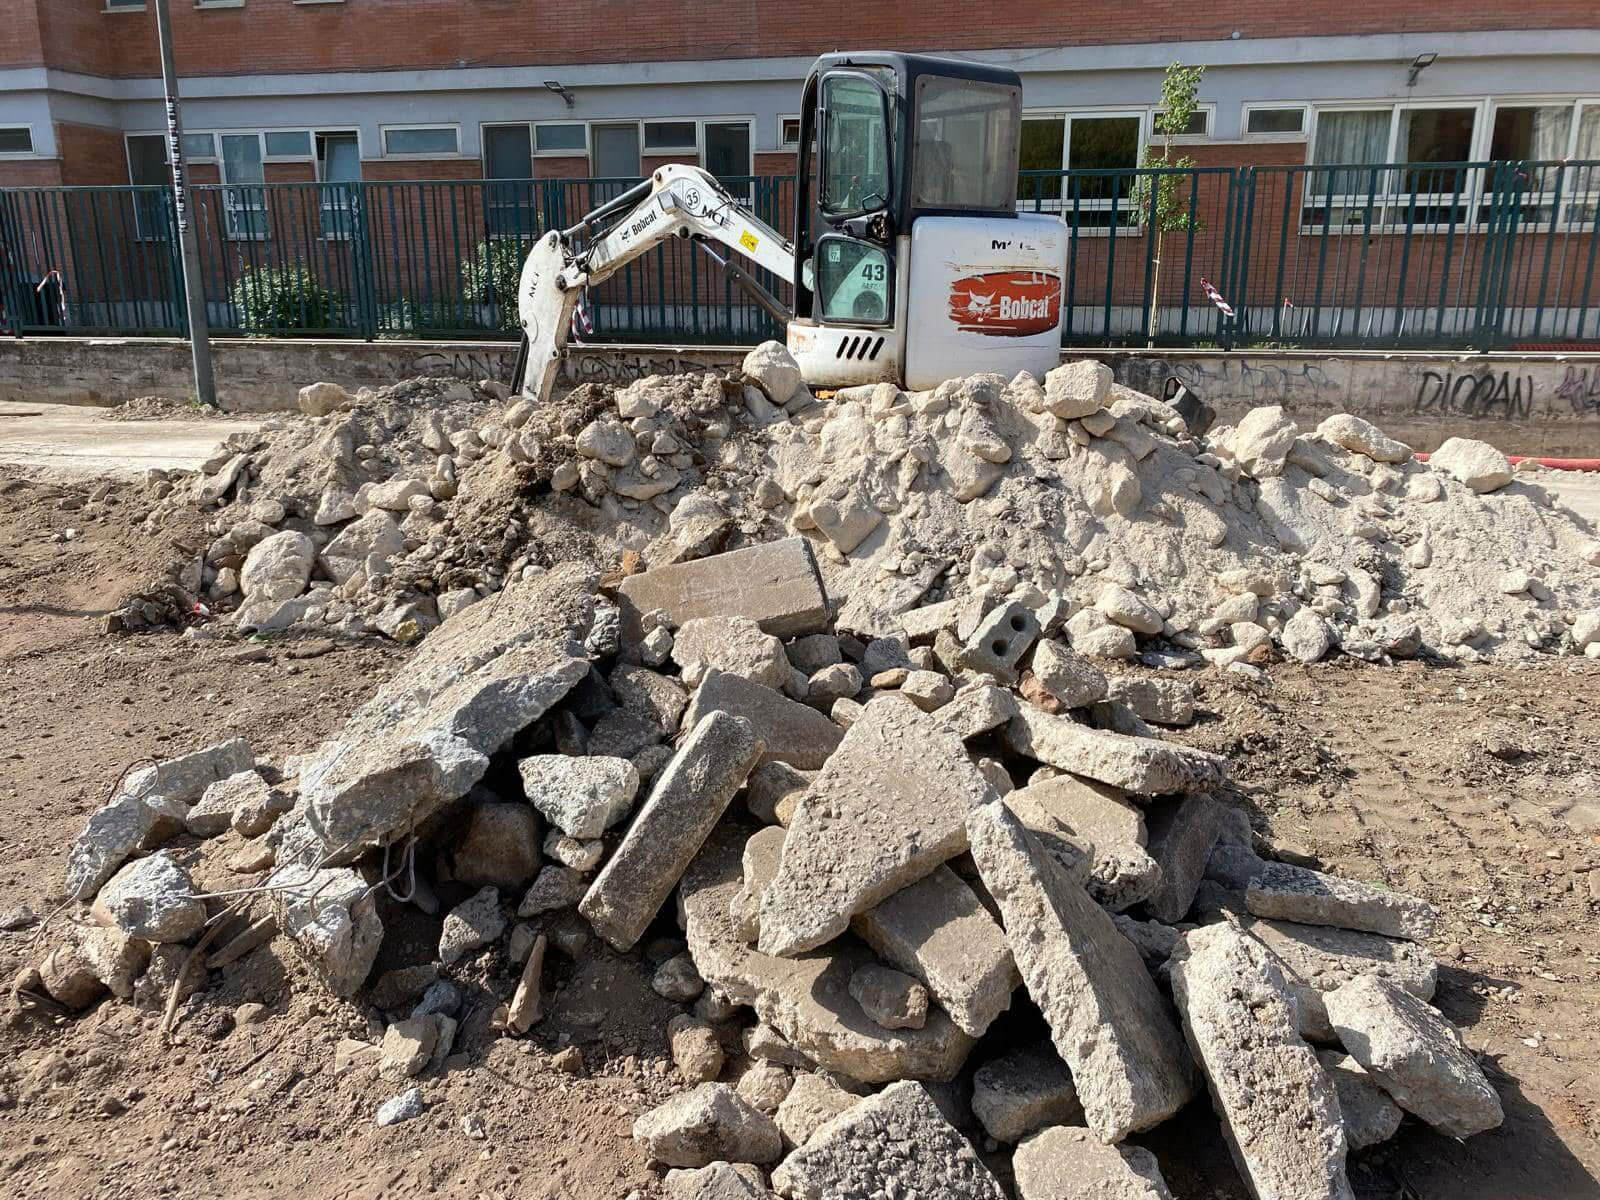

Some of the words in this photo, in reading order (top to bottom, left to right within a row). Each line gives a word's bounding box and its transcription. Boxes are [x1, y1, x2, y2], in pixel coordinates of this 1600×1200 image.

[686, 191, 699, 206] 35
[631, 209, 657, 236] Bobcat
[861, 263, 885, 281] 43
[1000, 295, 1049, 320] Bobcat
